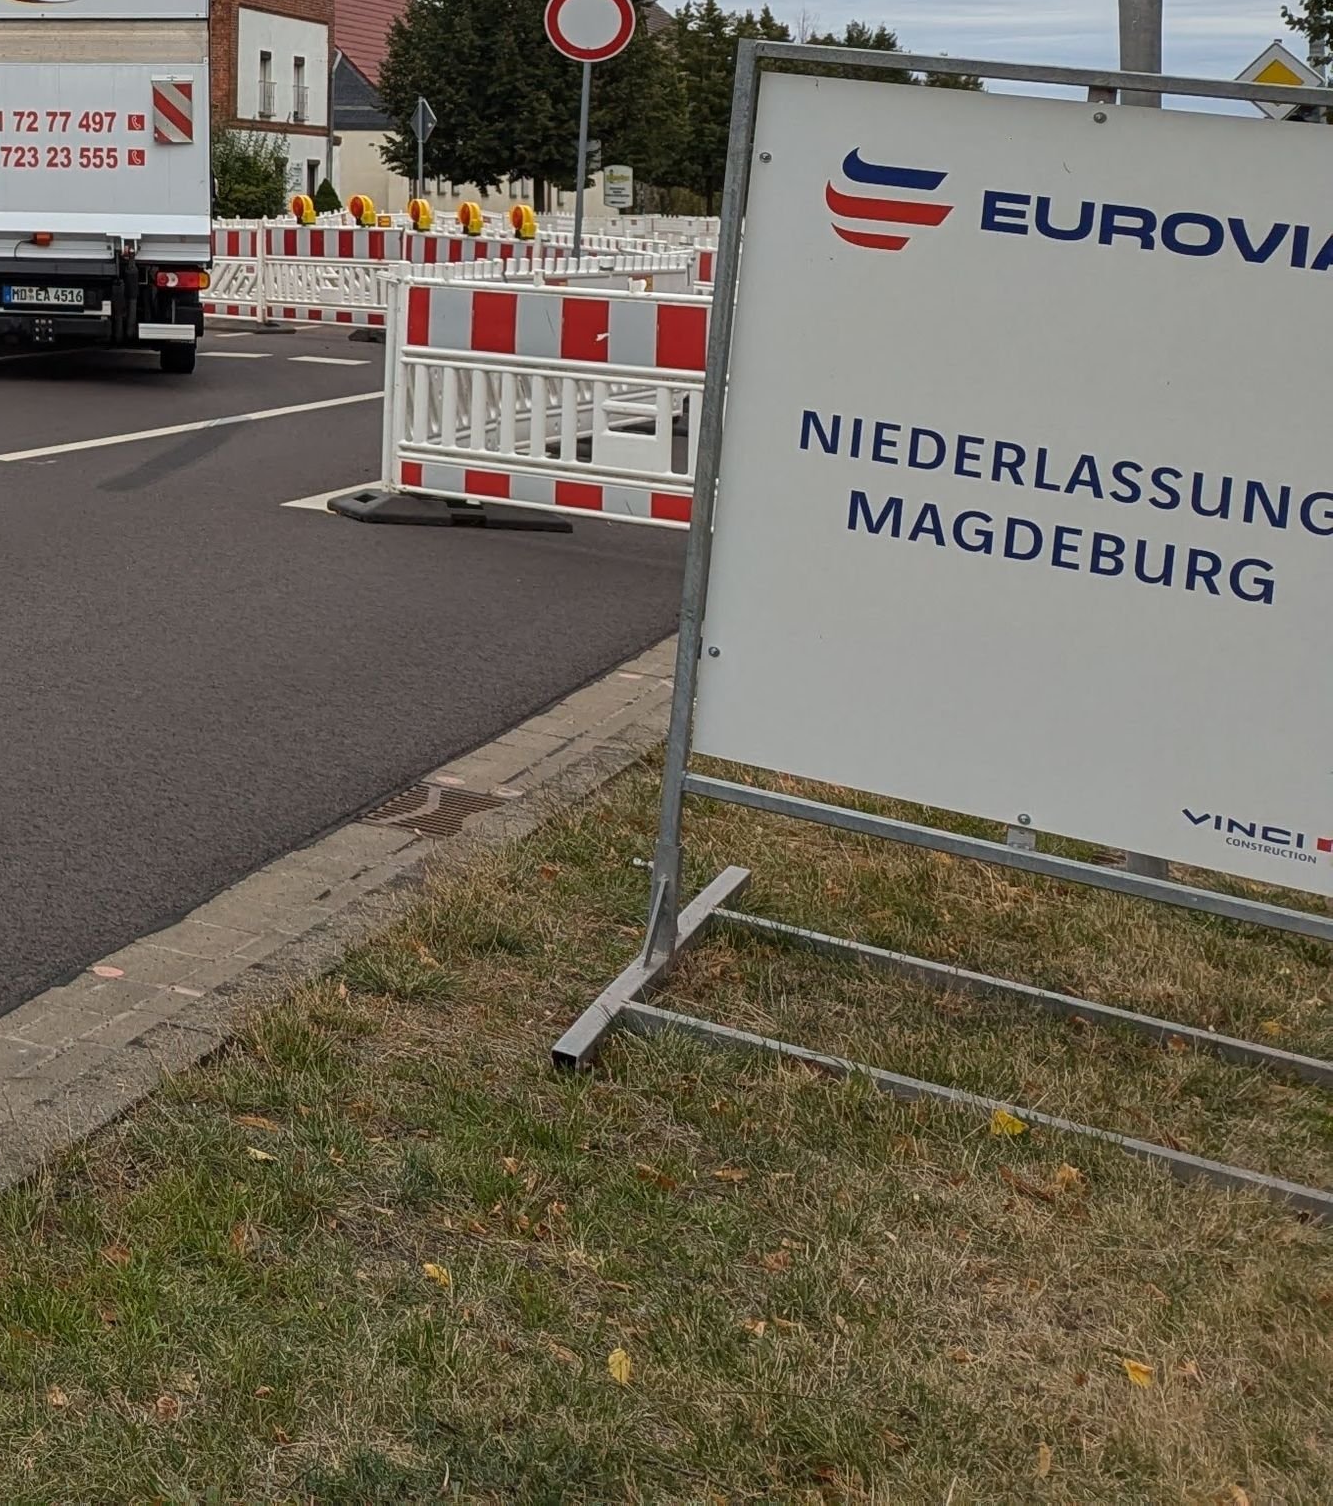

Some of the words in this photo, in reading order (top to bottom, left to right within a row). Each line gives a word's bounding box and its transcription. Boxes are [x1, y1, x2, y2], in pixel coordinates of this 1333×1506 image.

[13, 111, 39, 132] 72
[45, 111, 72, 133] 77
[78, 111, 117, 133] 497
[0, 146, 39, 168] 723
[46, 146, 72, 168] 23
[79, 147, 118, 169] 555
[798, 409, 1333, 536] NIEDERLASSUNG
[846, 489, 1275, 605] MAGDEBURG
[1182, 808, 1305, 849] VINCI
[1225, 836, 1317, 864] CONSTRUCTION
